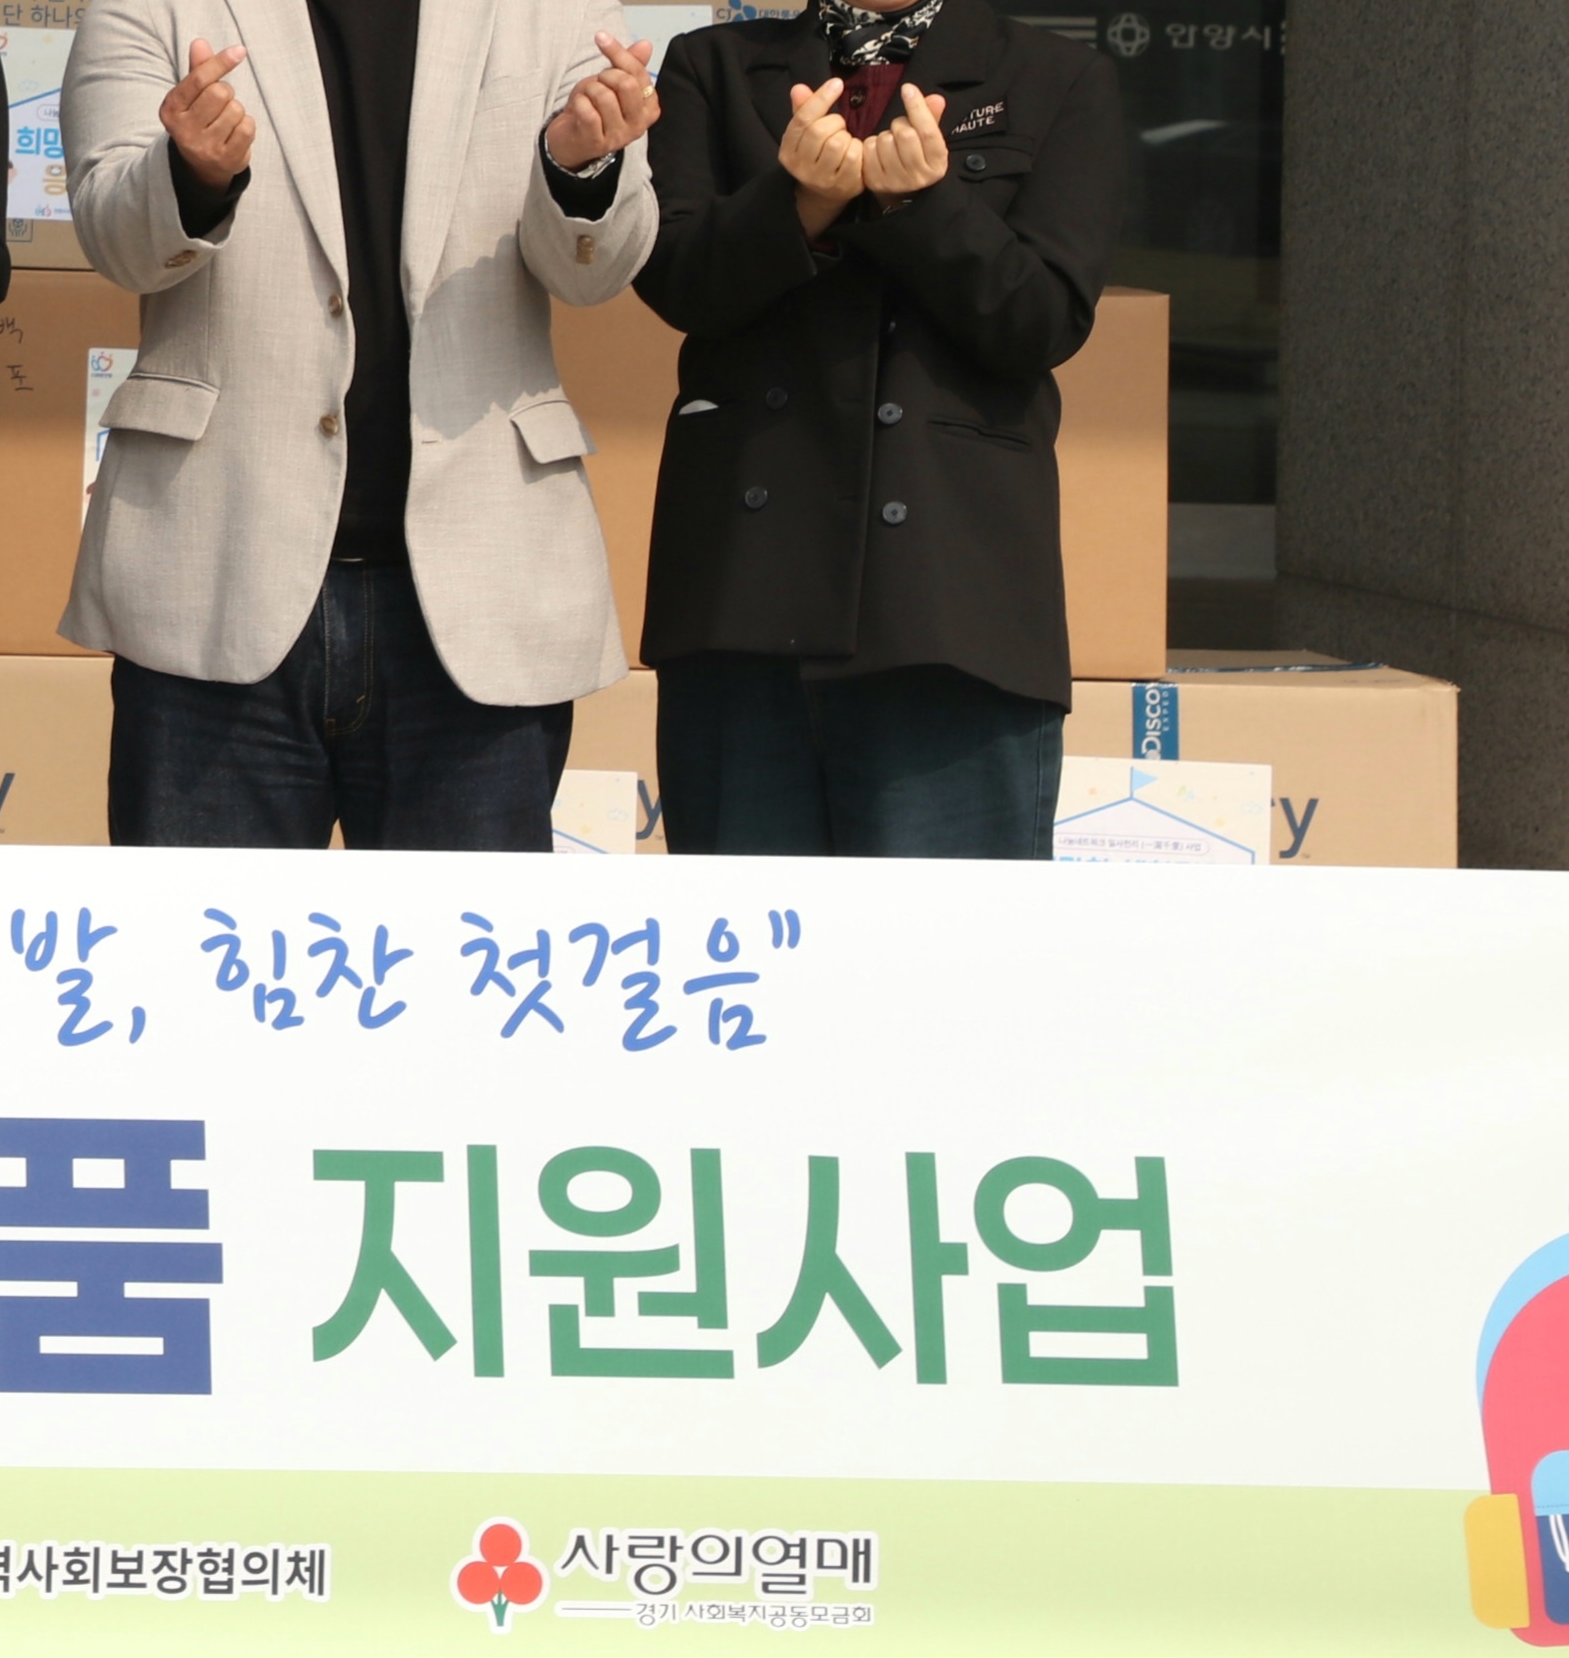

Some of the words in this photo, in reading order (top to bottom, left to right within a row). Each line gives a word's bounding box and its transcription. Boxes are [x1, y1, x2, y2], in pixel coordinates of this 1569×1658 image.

[3, 5, 23, 26] 단
[716, 8, 732, 21] CJ
[1165, 23, 1271, 50] 안양시
[15, 126, 65, 159] 희망
[202, 908, 413, 1031] 힘찬
[312, 1146, 1179, 1386] 지원사업
[561, 1534, 872, 1596] 사랑의열매
[636, 1603, 677, 1626] 경기
[684, 1604, 872, 1628] 사회복지공동모금회
